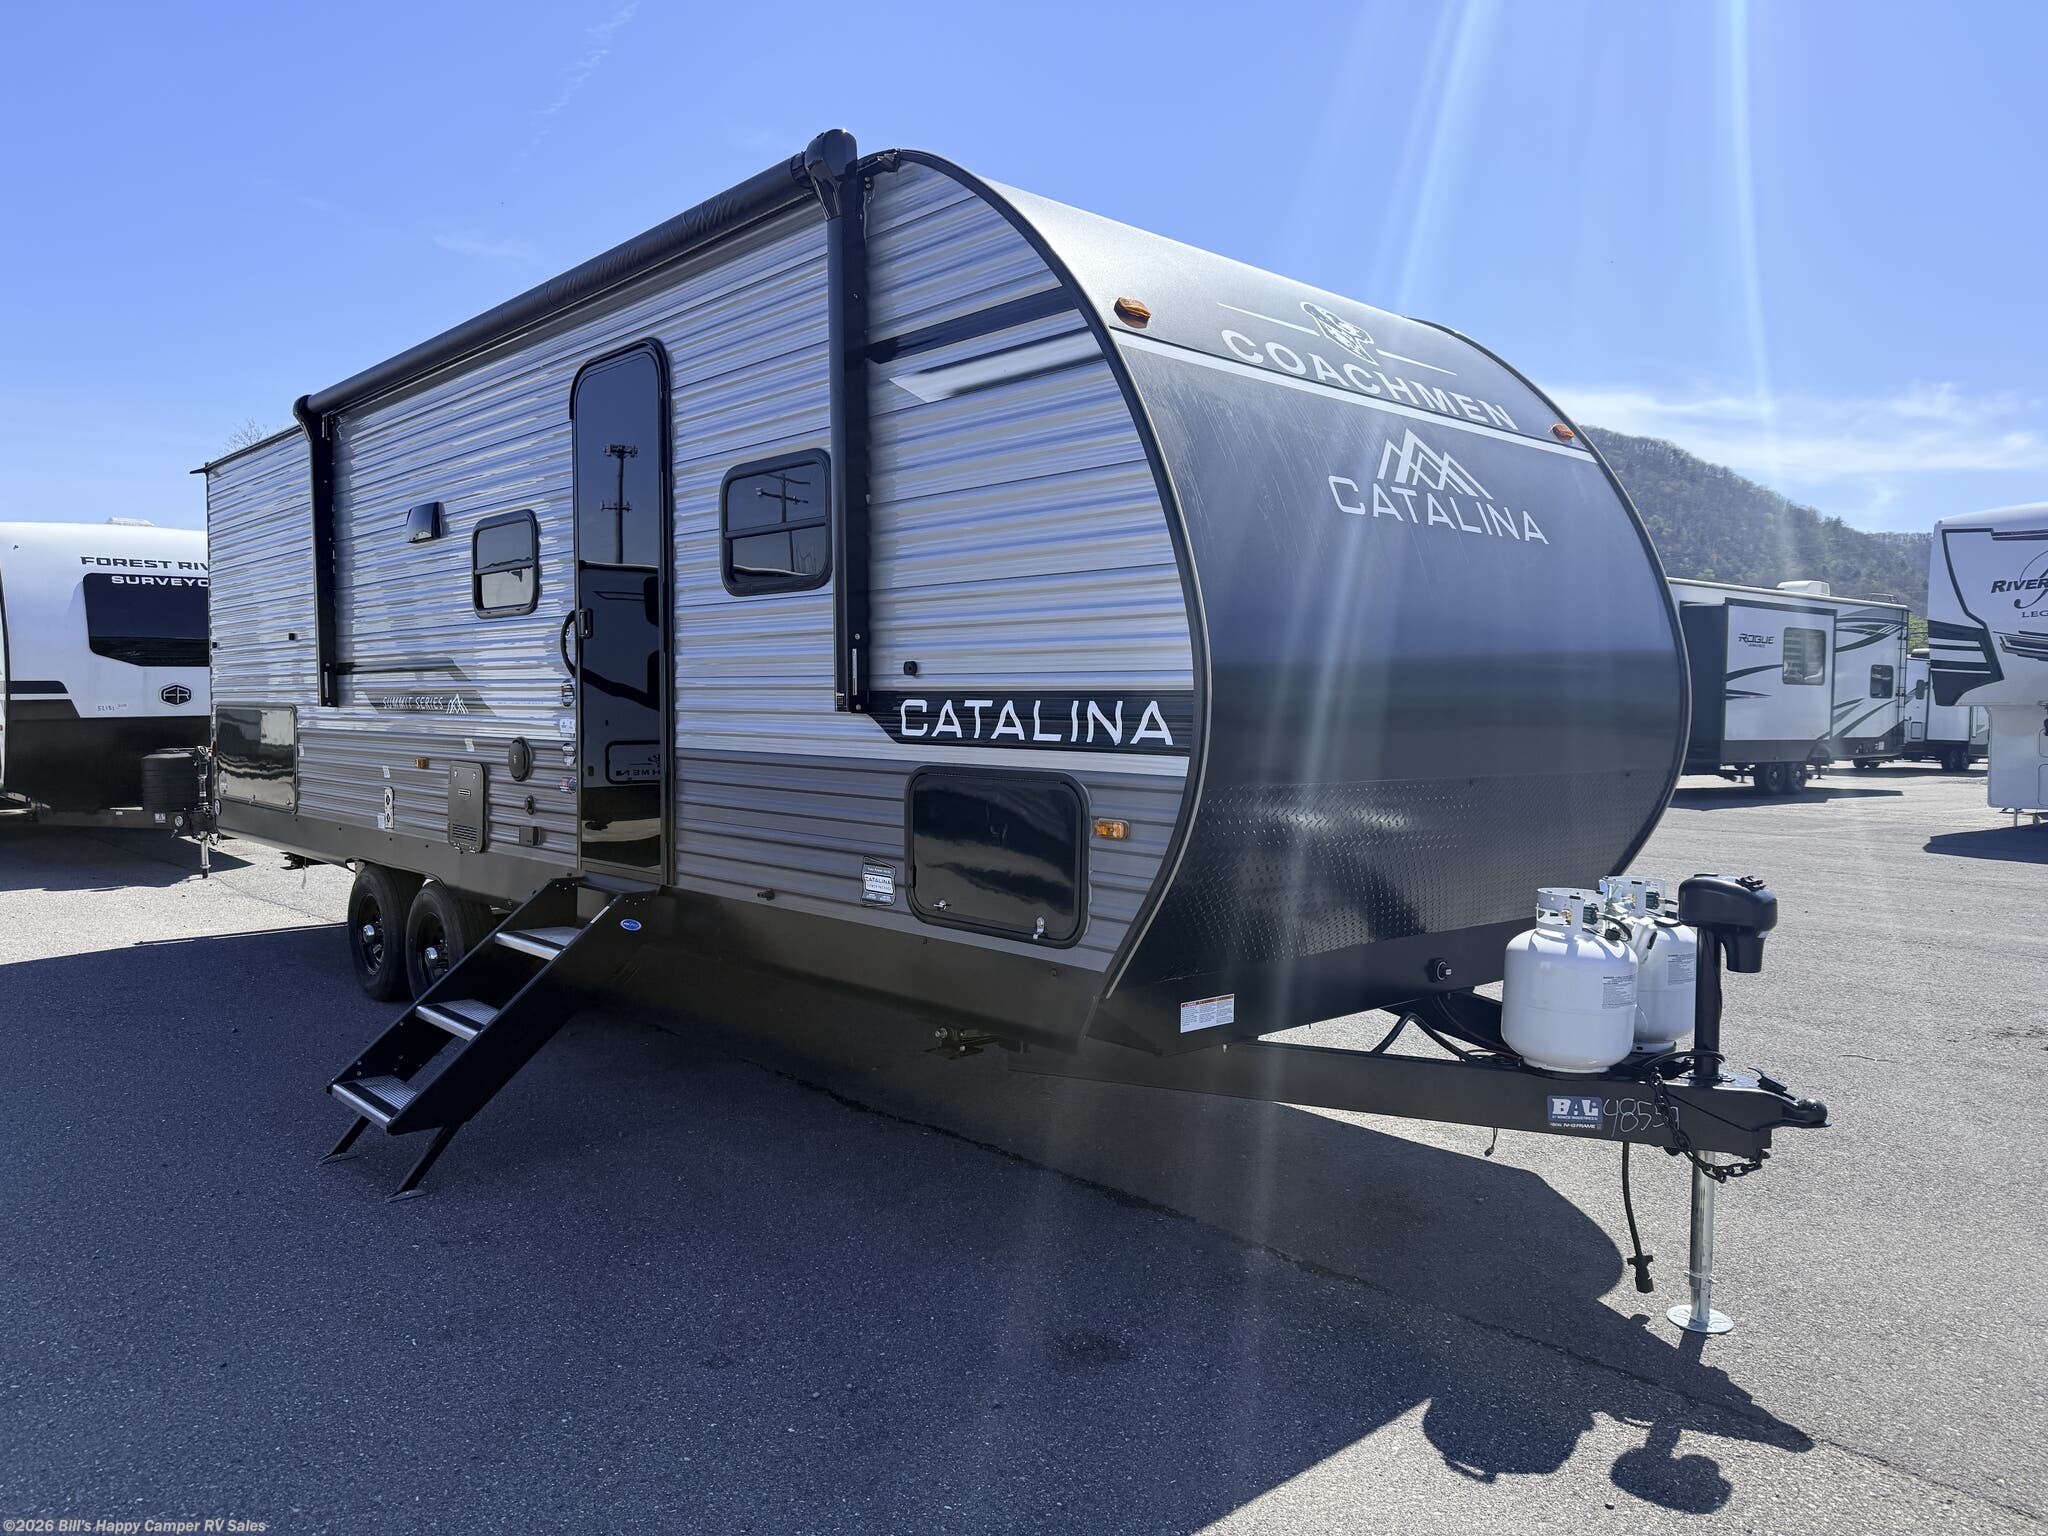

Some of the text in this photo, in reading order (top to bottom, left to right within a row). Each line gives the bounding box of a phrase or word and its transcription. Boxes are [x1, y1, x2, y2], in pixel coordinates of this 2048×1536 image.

[1221, 329, 1518, 430] COACHMEN
[1328, 475, 1549, 545] CATALINA
[80, 556, 171, 568] FOREST
[1738, 633, 1775, 645] ROGUE
[383, 696, 443, 710] SUMMIT SERIES
[900, 698, 1174, 747] CATALINA
[1552, 1098, 1599, 1117] BAL
